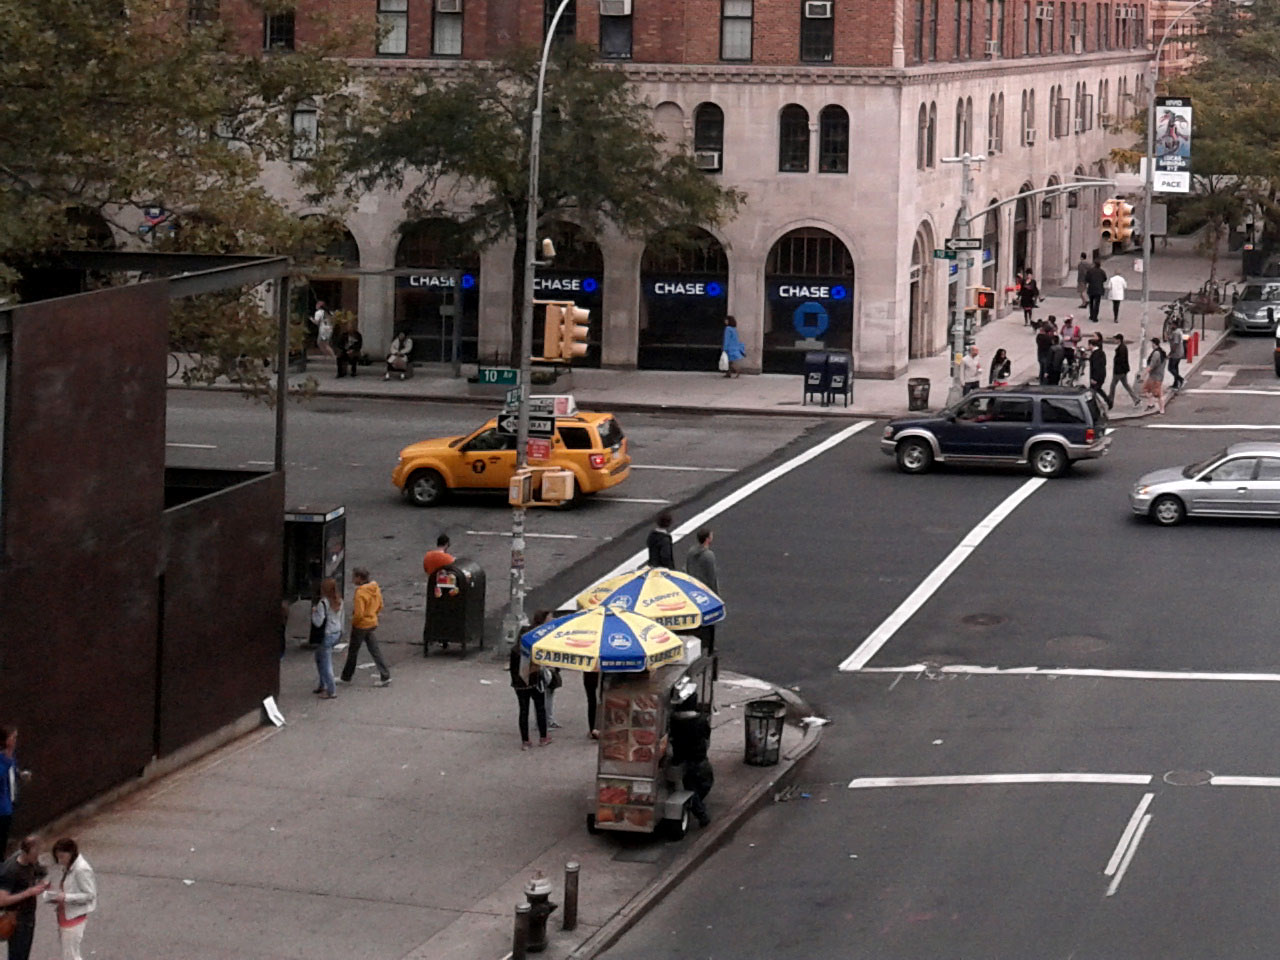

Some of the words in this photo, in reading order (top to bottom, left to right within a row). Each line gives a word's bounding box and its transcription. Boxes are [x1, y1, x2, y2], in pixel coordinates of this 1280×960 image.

[1161, 180, 1182, 188] PACE
[410, 275, 455, 287] CHASE
[533, 278, 581, 291] CHASE
[654, 282, 705, 295] CHASE
[779, 285, 830, 298] CHASE
[484, 370, 498, 382] 10
[655, 614, 697, 628] BRETT
[534, 649, 595, 667] SABRETT
